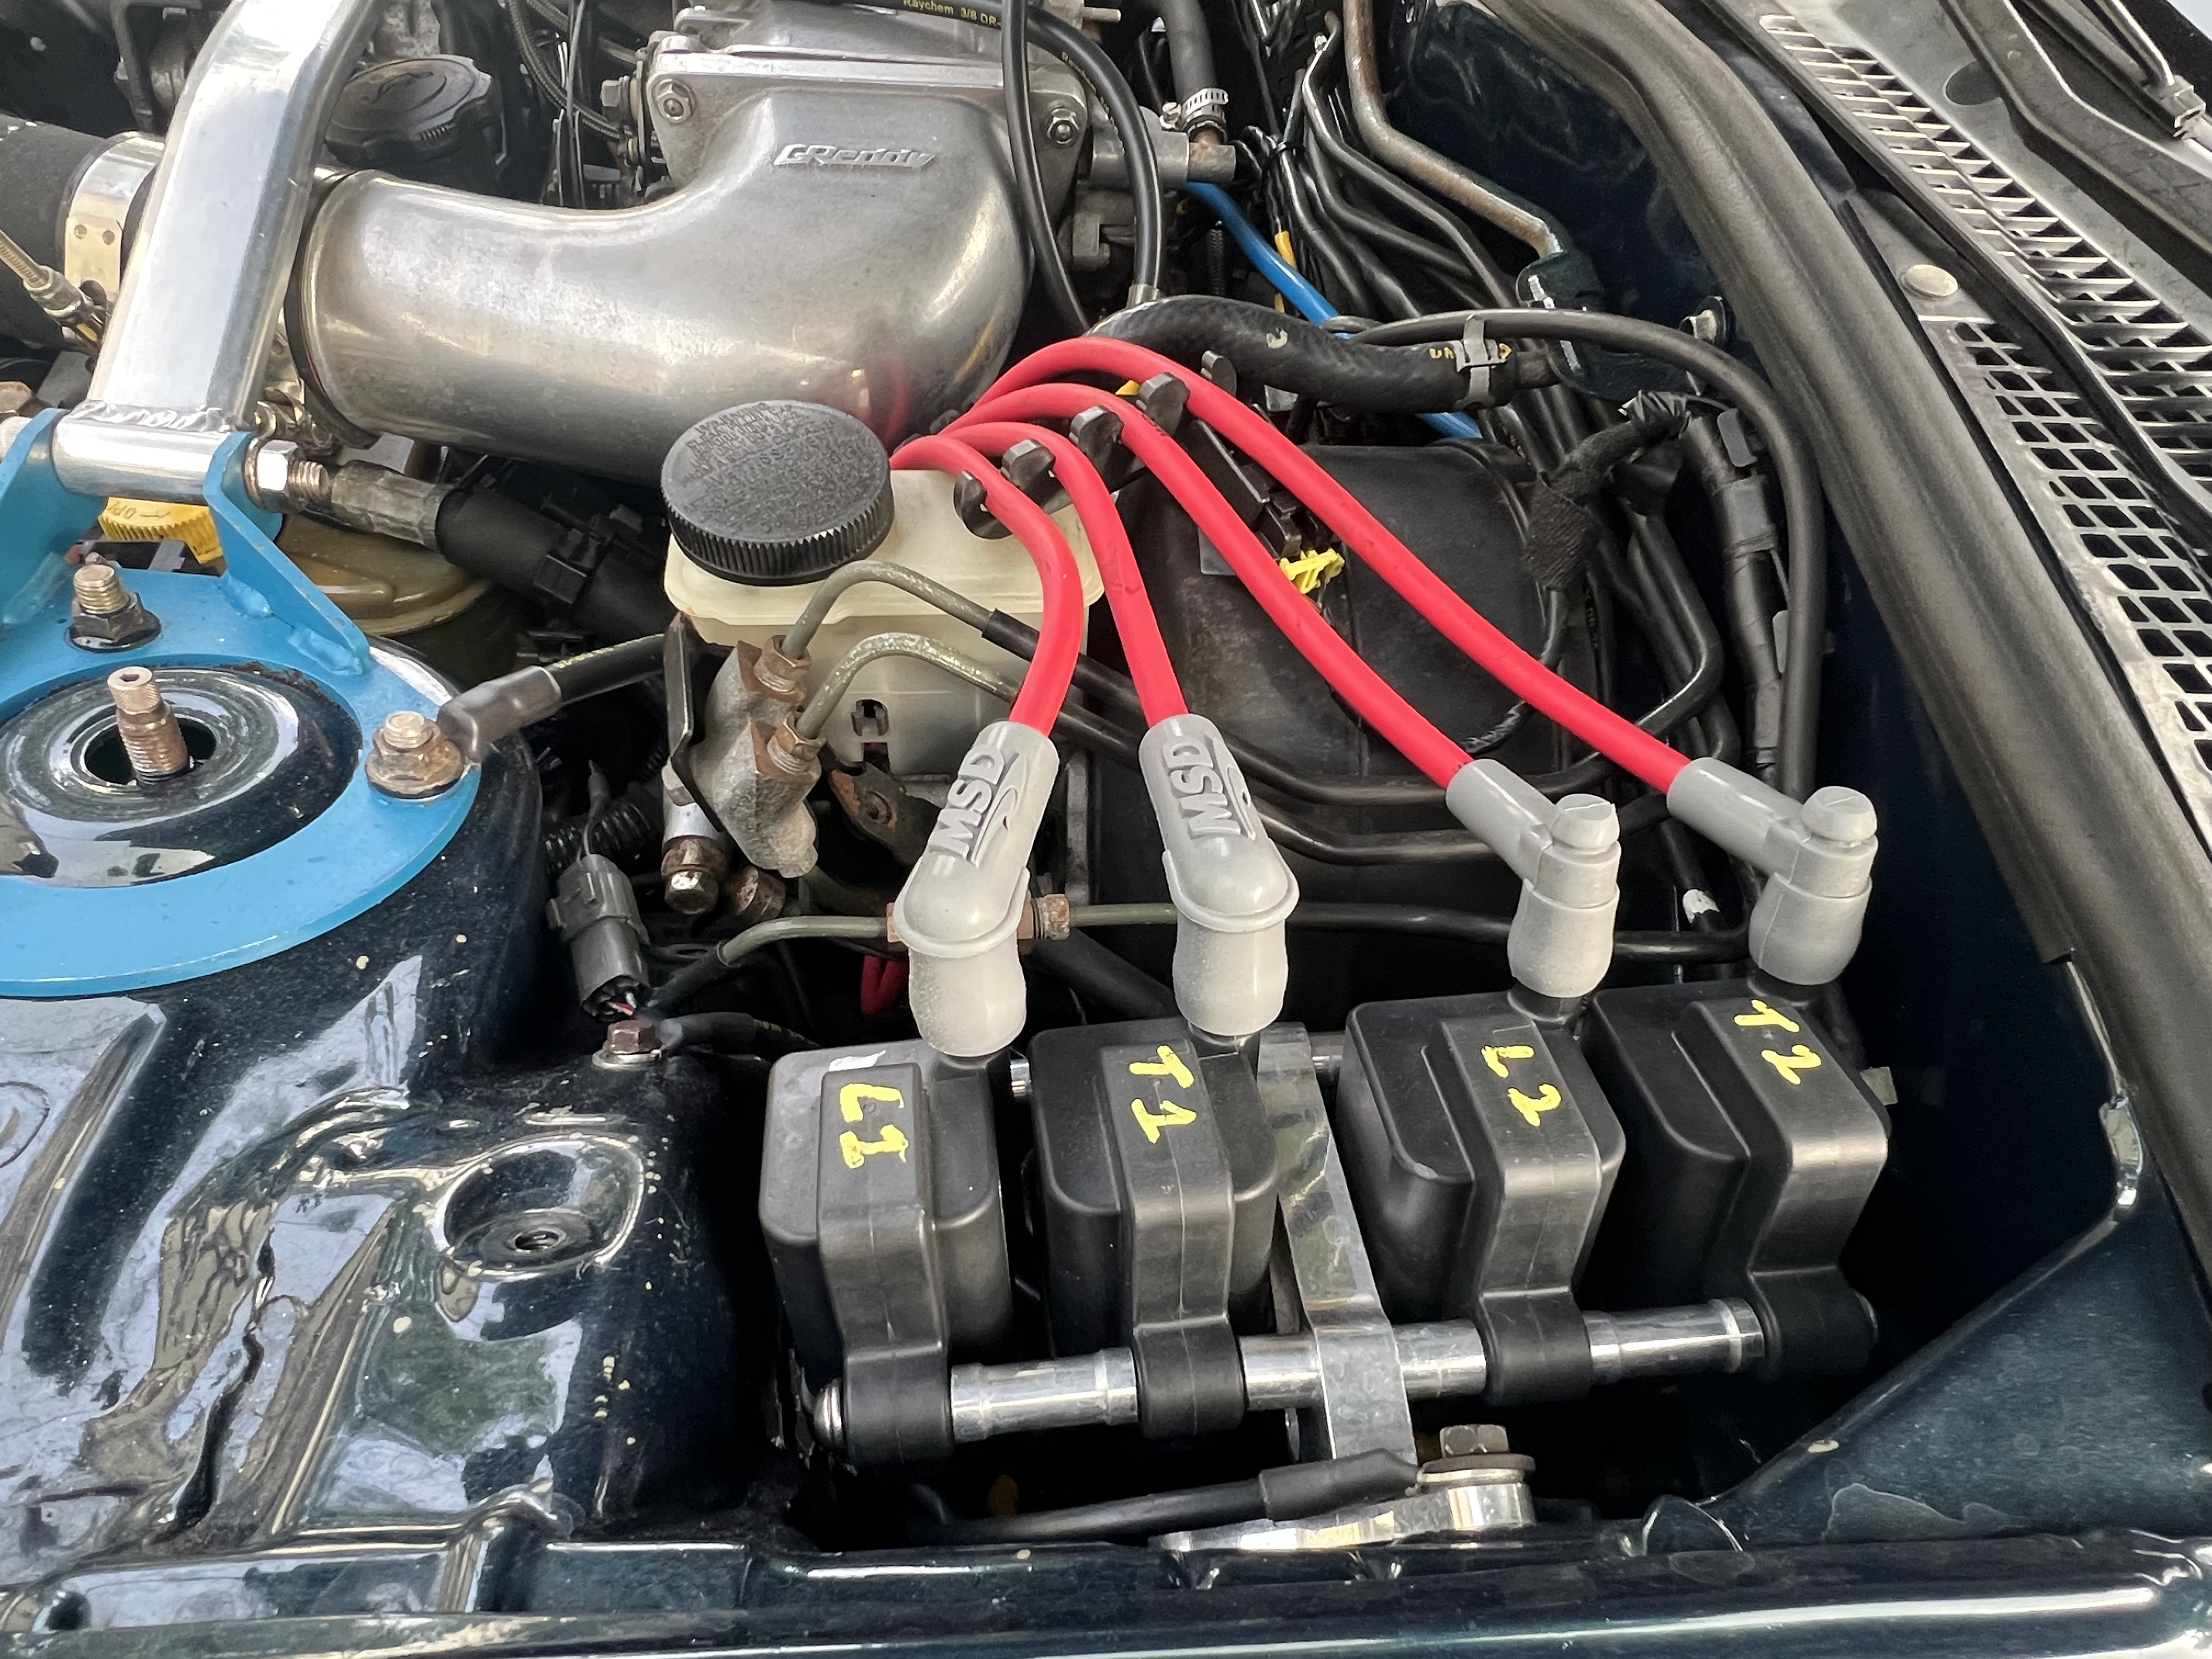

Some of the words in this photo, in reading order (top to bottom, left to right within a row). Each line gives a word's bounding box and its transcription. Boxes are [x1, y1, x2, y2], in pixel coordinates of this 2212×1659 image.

[961, 7, 977, 21] 3/8
[774, 144, 935, 168] GReddy
[928, 744, 1005, 859] MSD
[1163, 741, 1241, 837] MSD
